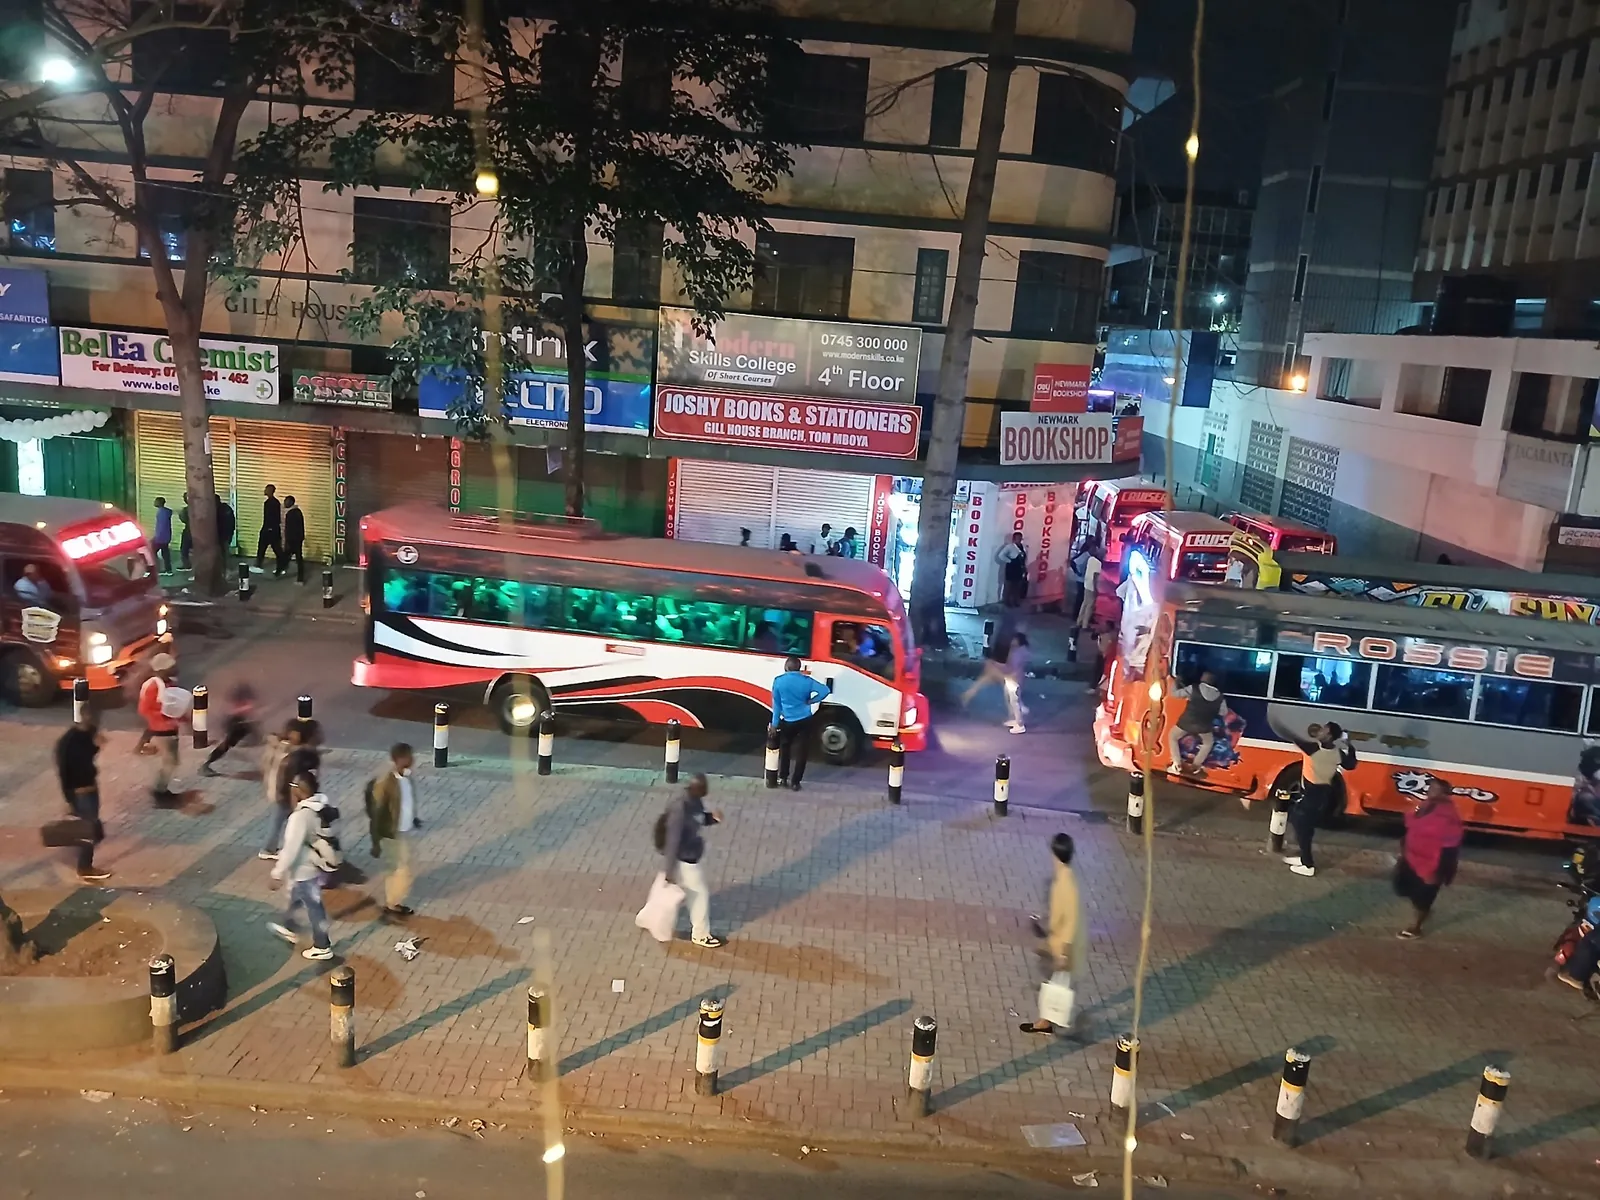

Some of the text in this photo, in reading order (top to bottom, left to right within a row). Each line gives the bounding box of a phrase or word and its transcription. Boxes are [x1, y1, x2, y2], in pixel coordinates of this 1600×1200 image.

[0, 313, 48, 324] SAFARITECH
[224, 297, 279, 317] GILL
[61, 330, 148, 362] BelEa
[821, 333, 908, 351] 0745 300 000
[688, 350, 796, 375] Skills College
[822, 350, 905, 363] www.modernskills.co.ke
[92, 360, 111, 371] For
[113, 362, 162, 378] Delivery:
[228, 373, 249, 384] 462
[707, 371, 773, 384] Of Short Courses
[848, 369, 905, 391] Floor
[664, 393, 913, 434] JOSHY BOOKS & STATIONERS
[1038, 415, 1079, 425] NEWMARK
[704, 421, 869, 447] GILL HOUSE BRANCH, TOM MBOYA
[1004, 426, 1109, 461] BOOKSHOP
[668, 473, 676, 511] JOSHY
[872, 493, 885, 563] JOSHY BOOKS
[962, 496, 983, 600] BOOKSHOP
